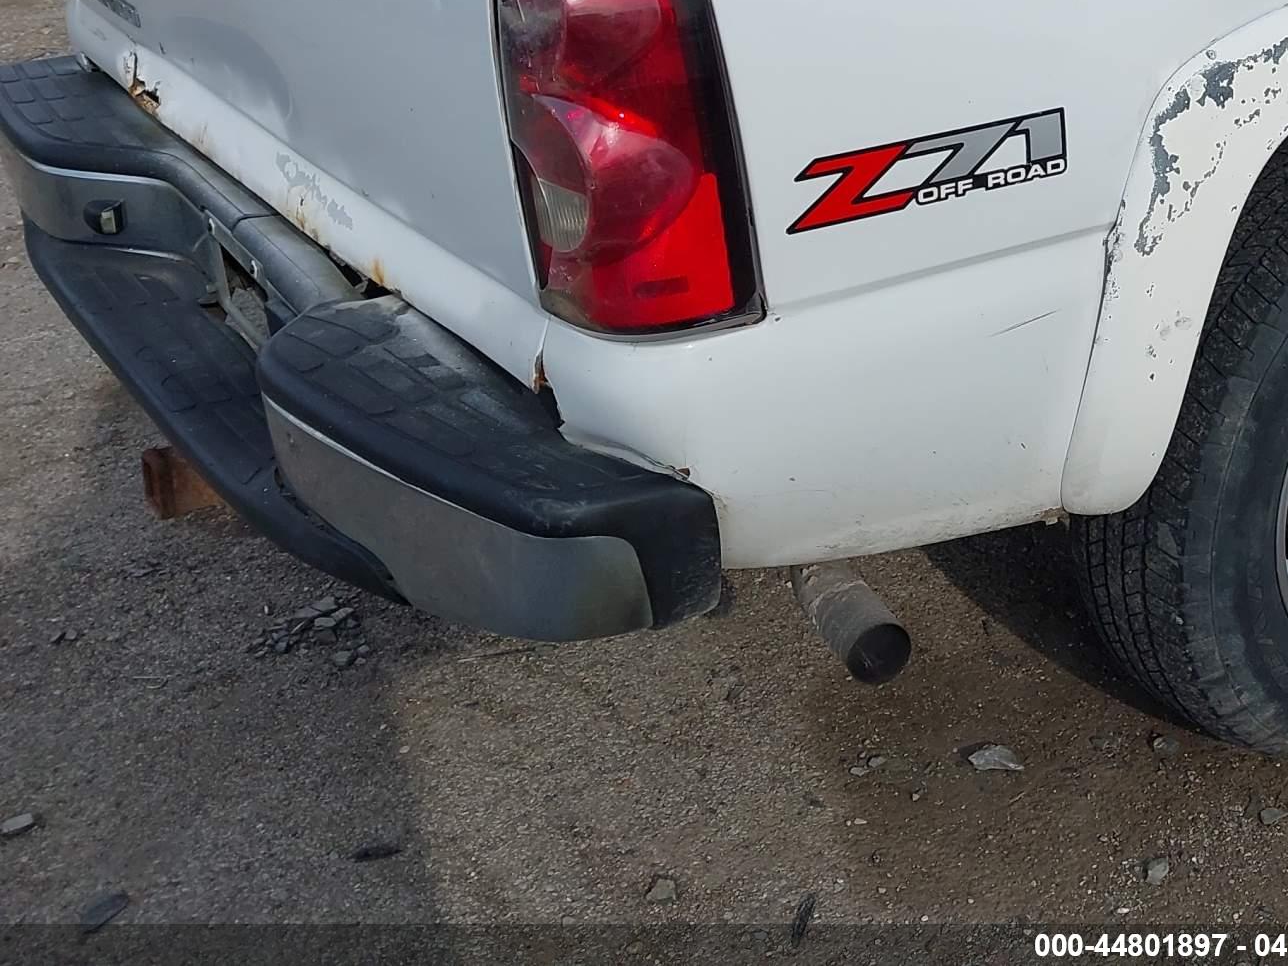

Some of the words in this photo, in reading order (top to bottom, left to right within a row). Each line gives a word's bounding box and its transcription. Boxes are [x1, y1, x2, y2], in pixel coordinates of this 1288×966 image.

[786, 106, 1068, 235] Z71
[916, 178, 975, 205] OFF
[984, 157, 1066, 189] ROAD
